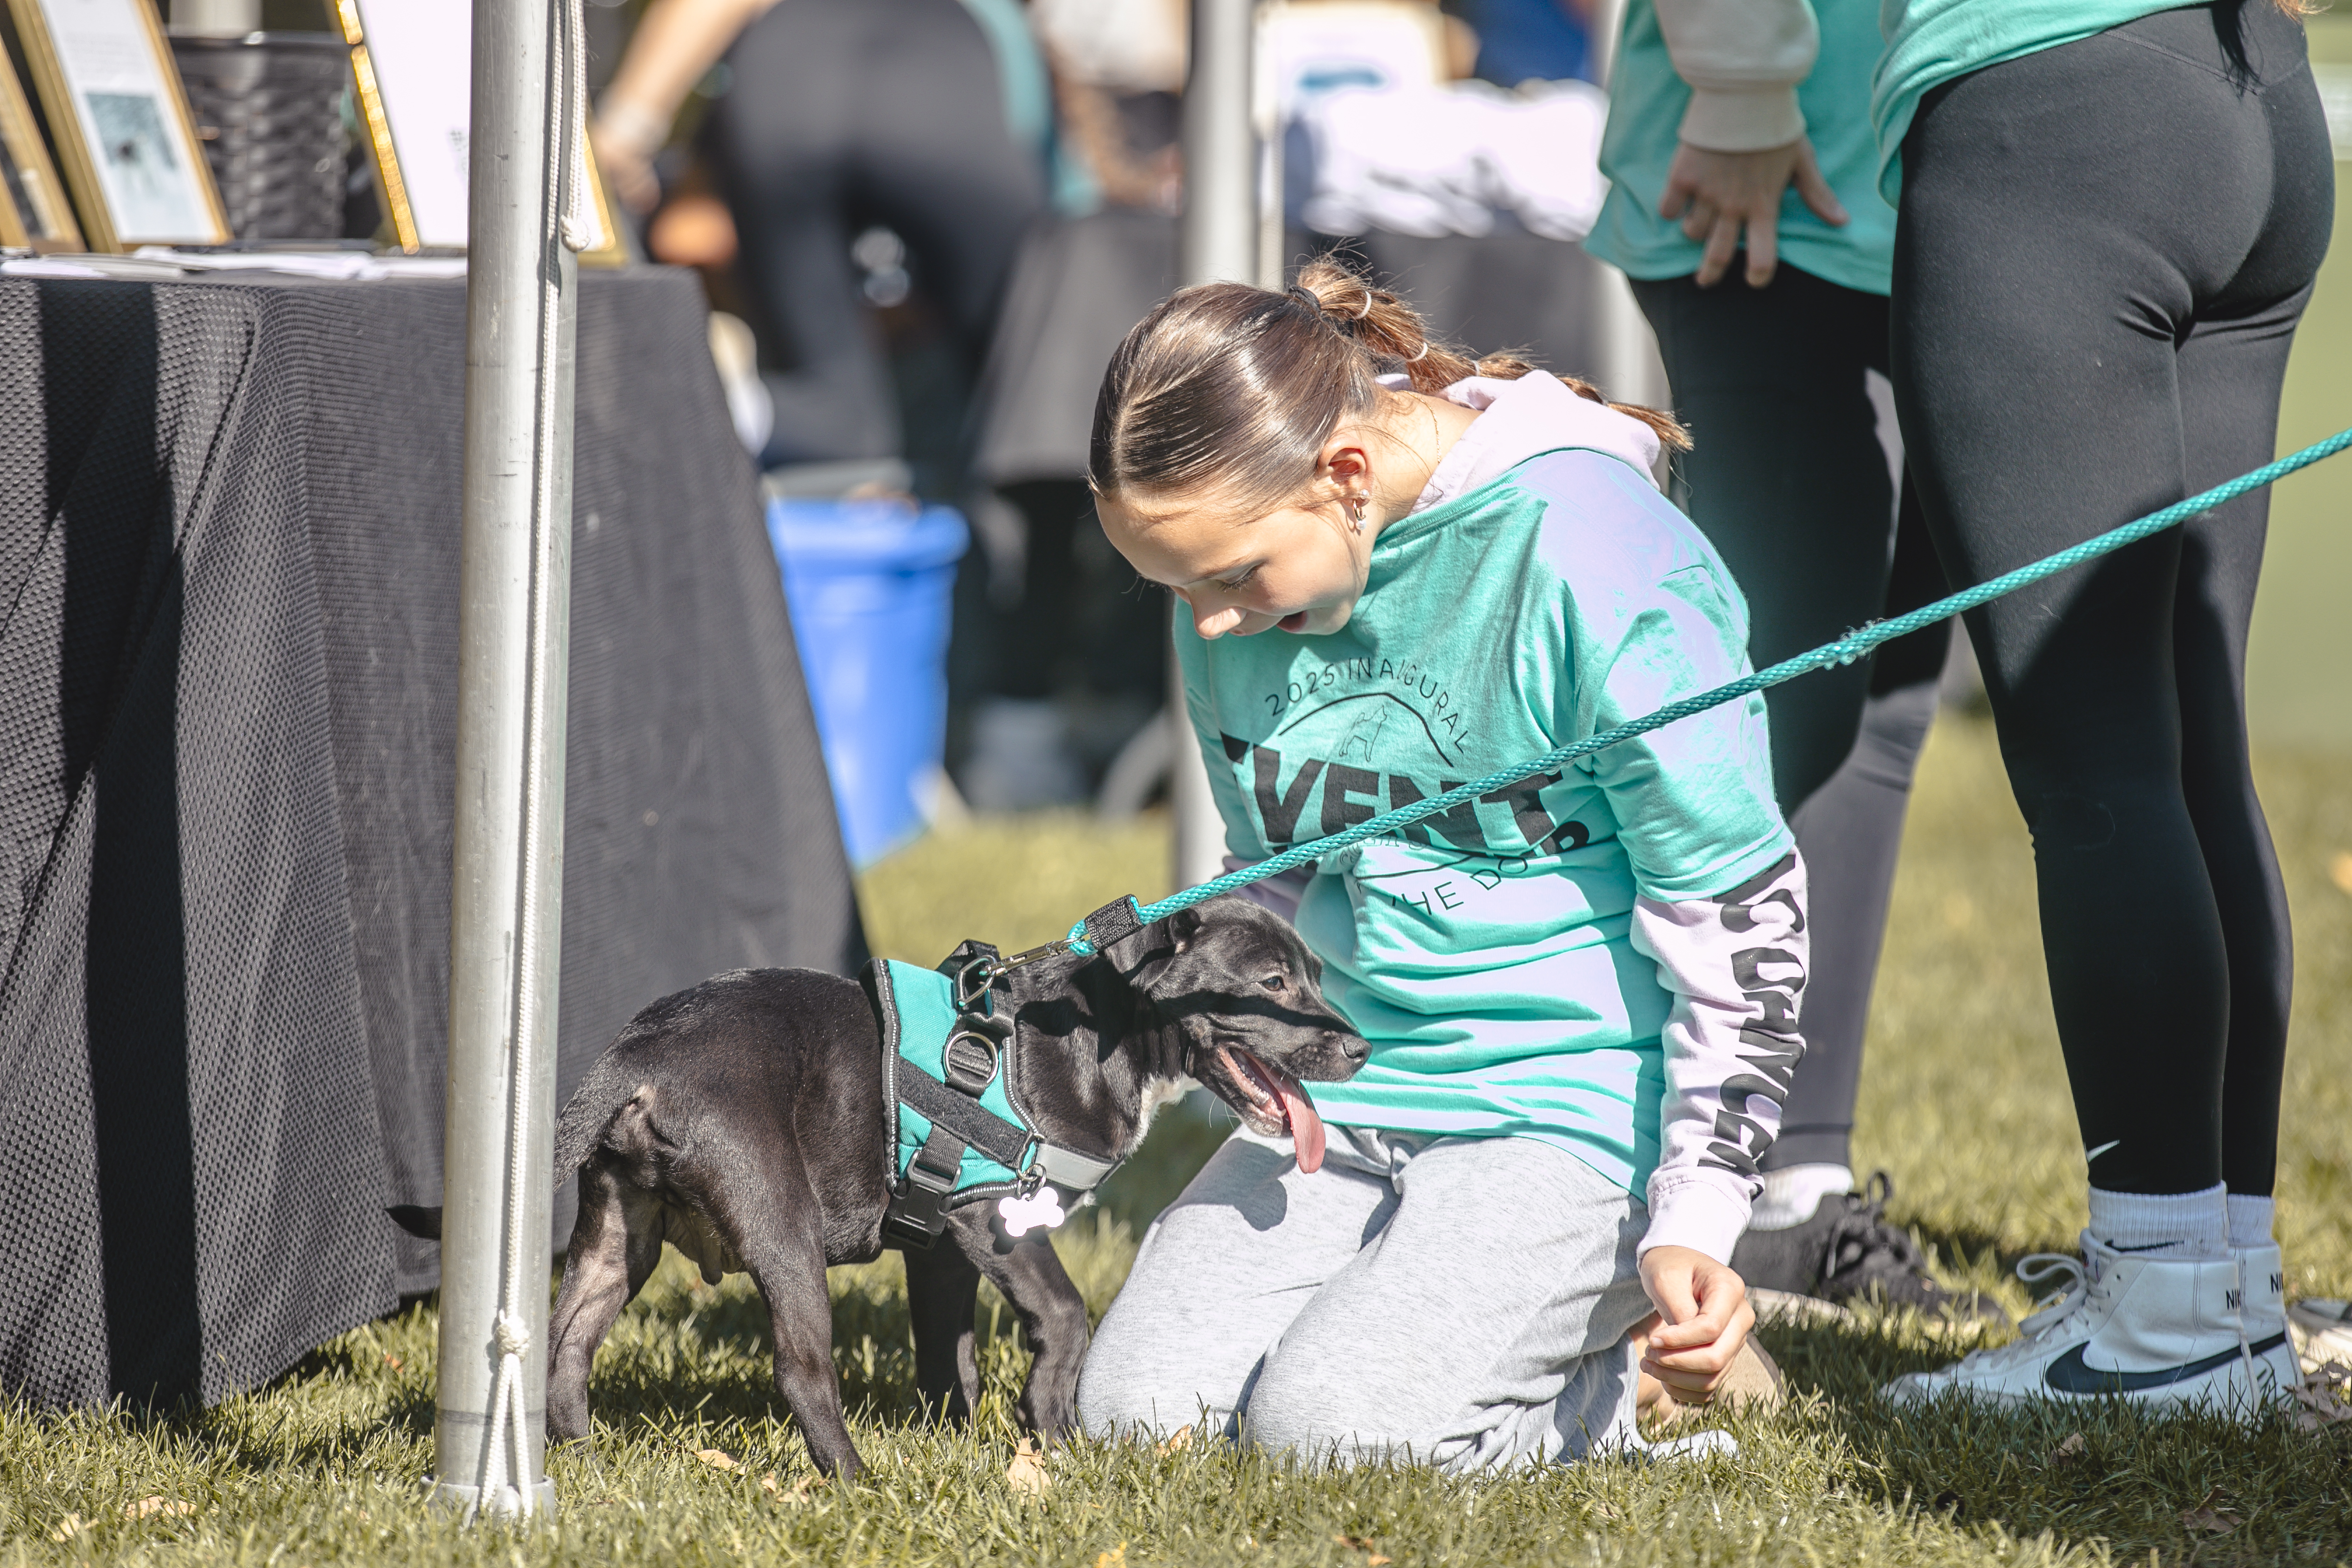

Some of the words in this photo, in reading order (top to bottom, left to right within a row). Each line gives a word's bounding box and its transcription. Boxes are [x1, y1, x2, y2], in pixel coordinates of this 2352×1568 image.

[1265, 664, 1335, 717] 2025
[1219, 729, 1564, 852] VENT
[1392, 881, 1464, 916] HE
